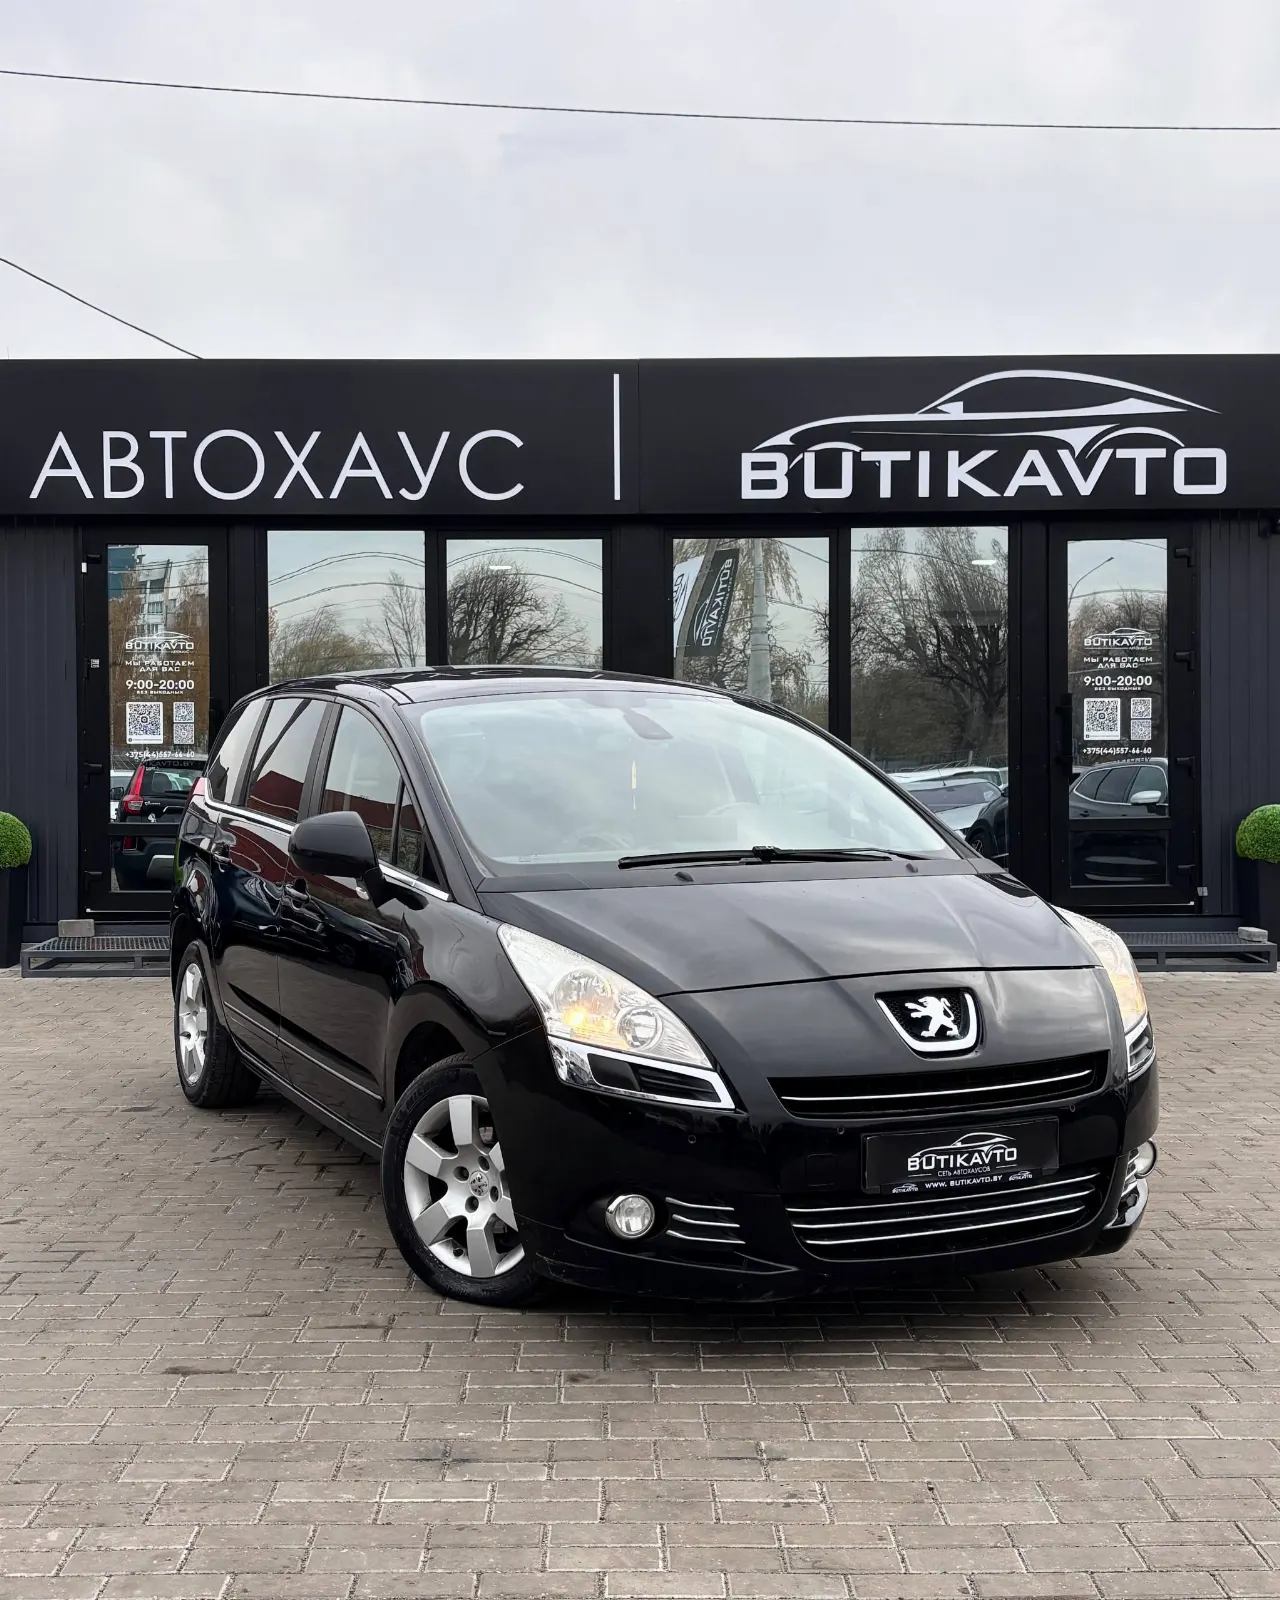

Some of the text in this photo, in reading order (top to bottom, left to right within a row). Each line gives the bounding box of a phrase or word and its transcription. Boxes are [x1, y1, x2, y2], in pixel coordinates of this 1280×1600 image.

[29, 428, 525, 501] АВТОХАУС
[741, 447, 1226, 500] BUTIKAVTO
[125, 641, 195, 650] BUTIKAVTO
[1083, 637, 1153, 646] BUTIKAVTO
[125, 679, 195, 690] 9:00-20:00
[1083, 675, 1153, 686] 9:00-20:00
[1082, 746, 1152, 756] +375(44)557-66-60
[907, 1147, 1018, 1171] BUTIKAVTO
[937, 1165, 991, 1177] СЕТЬ АВТОХАУСОВ
[949, 1174, 1003, 1187] BUTIKAVTO.BY
